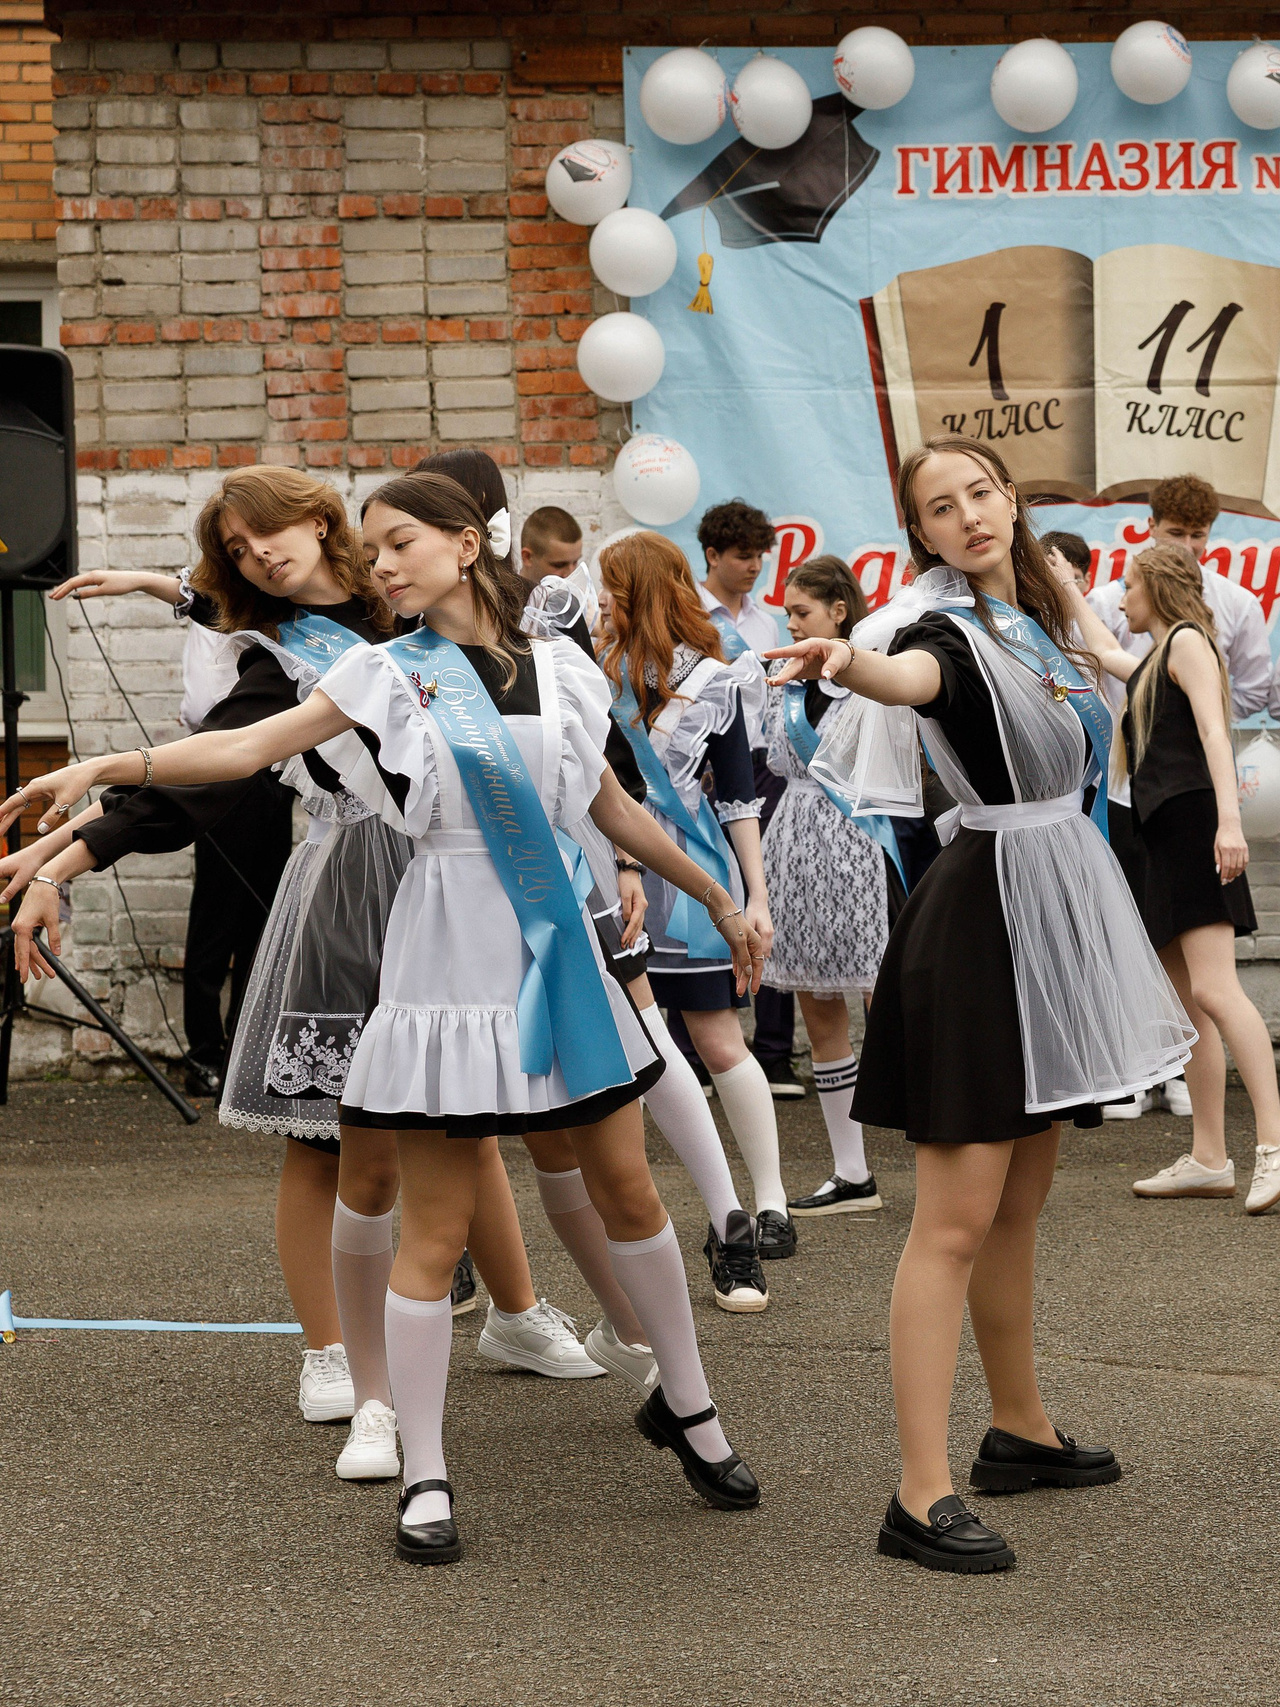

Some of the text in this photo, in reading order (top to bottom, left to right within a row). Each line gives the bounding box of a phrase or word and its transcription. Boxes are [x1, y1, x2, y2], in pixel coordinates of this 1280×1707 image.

[896, 140, 1238, 194] ГИМНАЗИЯ
[968, 301, 1010, 400] 1
[1137, 299, 1245, 398] 11
[941, 398, 1065, 441] КЛАСС
[1125, 401, 1246, 443] КЛАСС
[430, 667, 557, 904] Выпускница 2026
